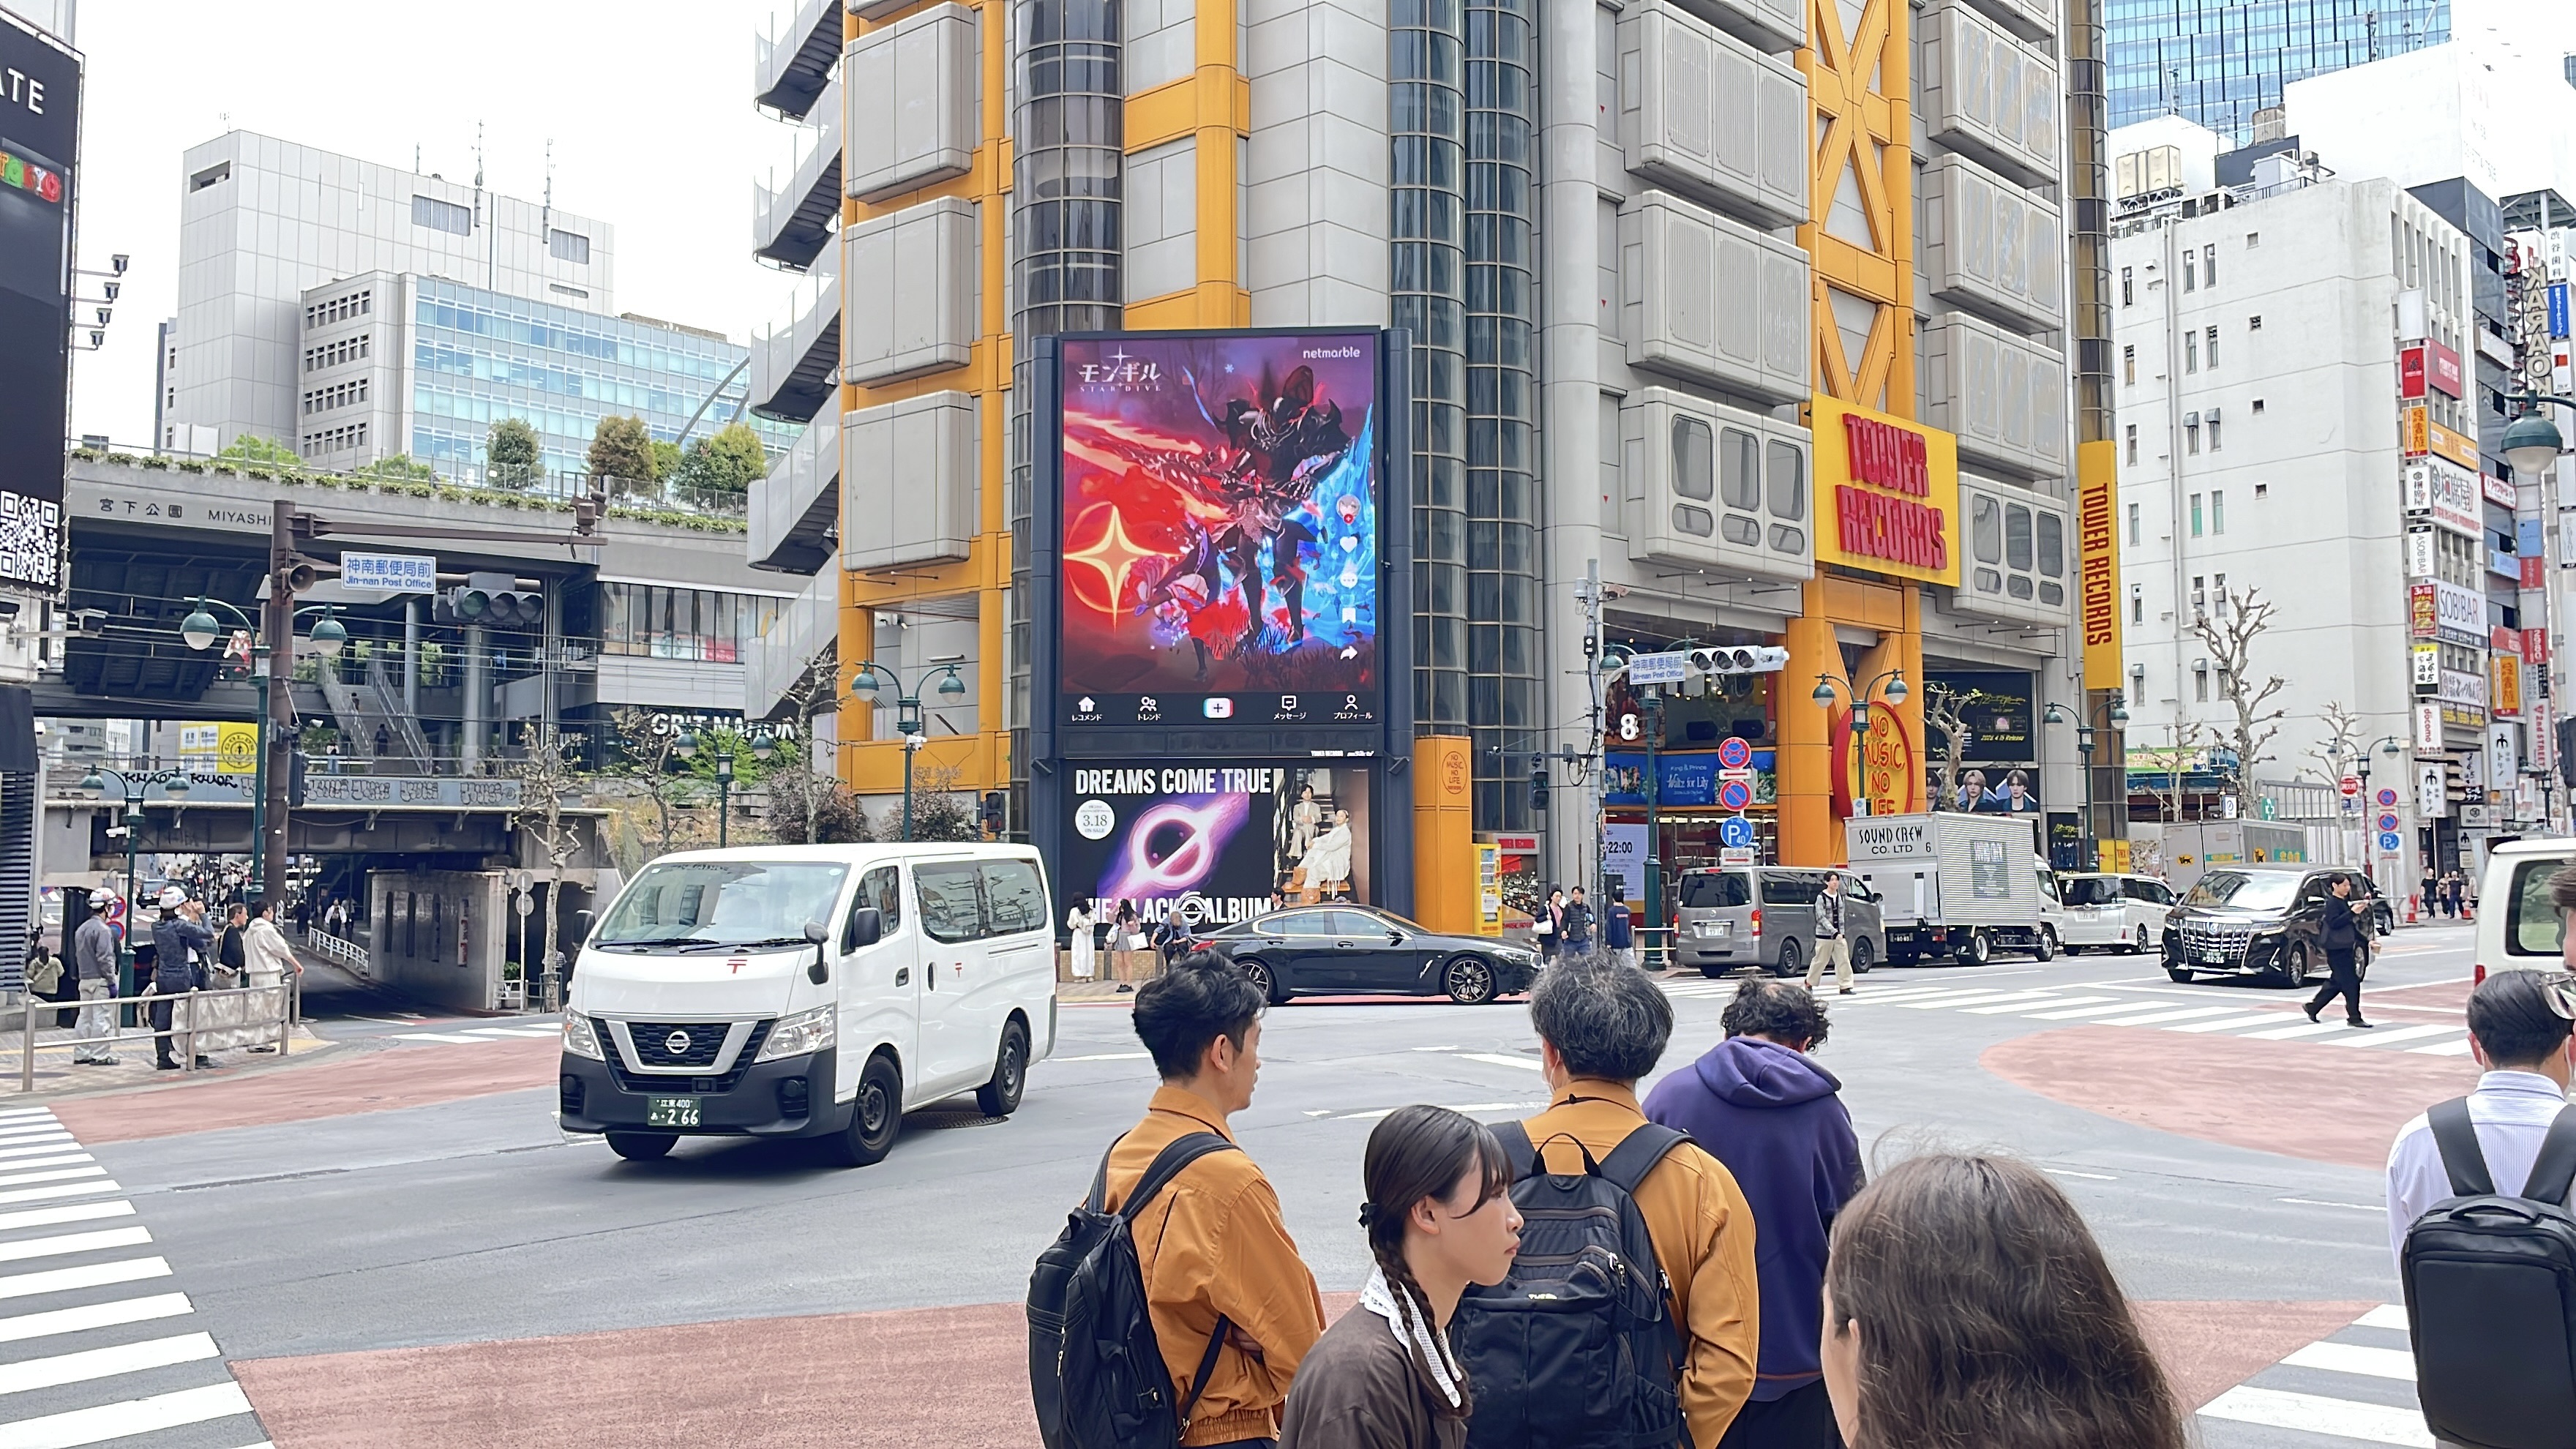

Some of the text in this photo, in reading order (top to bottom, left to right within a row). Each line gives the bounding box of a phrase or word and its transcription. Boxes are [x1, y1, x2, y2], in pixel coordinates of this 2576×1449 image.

[0, 67, 45, 115] TE
[1303, 345, 1360, 359] netmarble
[1079, 362, 1161, 382] モンギル
[1842, 413, 1930, 498] TOWER
[1835, 484, 1947, 570] RECORDS
[346, 557, 431, 577] 神南郵便局前
[2083, 482, 2112, 646] TOWER RECORDS
[346, 575, 432, 588] Jin-nan Post Office
[1632, 656, 1682, 672] 神南郵便局前
[1632, 673, 1652, 681] Jin-nan
[1652, 671, 1666, 679] Post
[1071, 711, 1373, 722] レコメンド トレンド メッセージ プロフィール
[2424, 708, 2432, 743] docomo
[1620, 714, 1639, 741] 8
[1871, 716, 1889, 738] NO
[2537, 735, 2546, 767] STREET
[1076, 768, 1272, 795] DREAMS COME TRUE
[1687, 777, 1696, 788] for
[1871, 772, 1890, 793] NO
[1083, 815, 1107, 826] 3.18
[1728, 825, 1746, 845] P 40
[1859, 825, 1922, 844] SOUND CREW
[2383, 836, 2392, 848] P
[1871, 845, 1913, 854] CO. LTD
[1925, 842, 1931, 853] 6
[1202, 897, 1272, 924] ALBUM
[676, 1099, 690, 1108] 400
